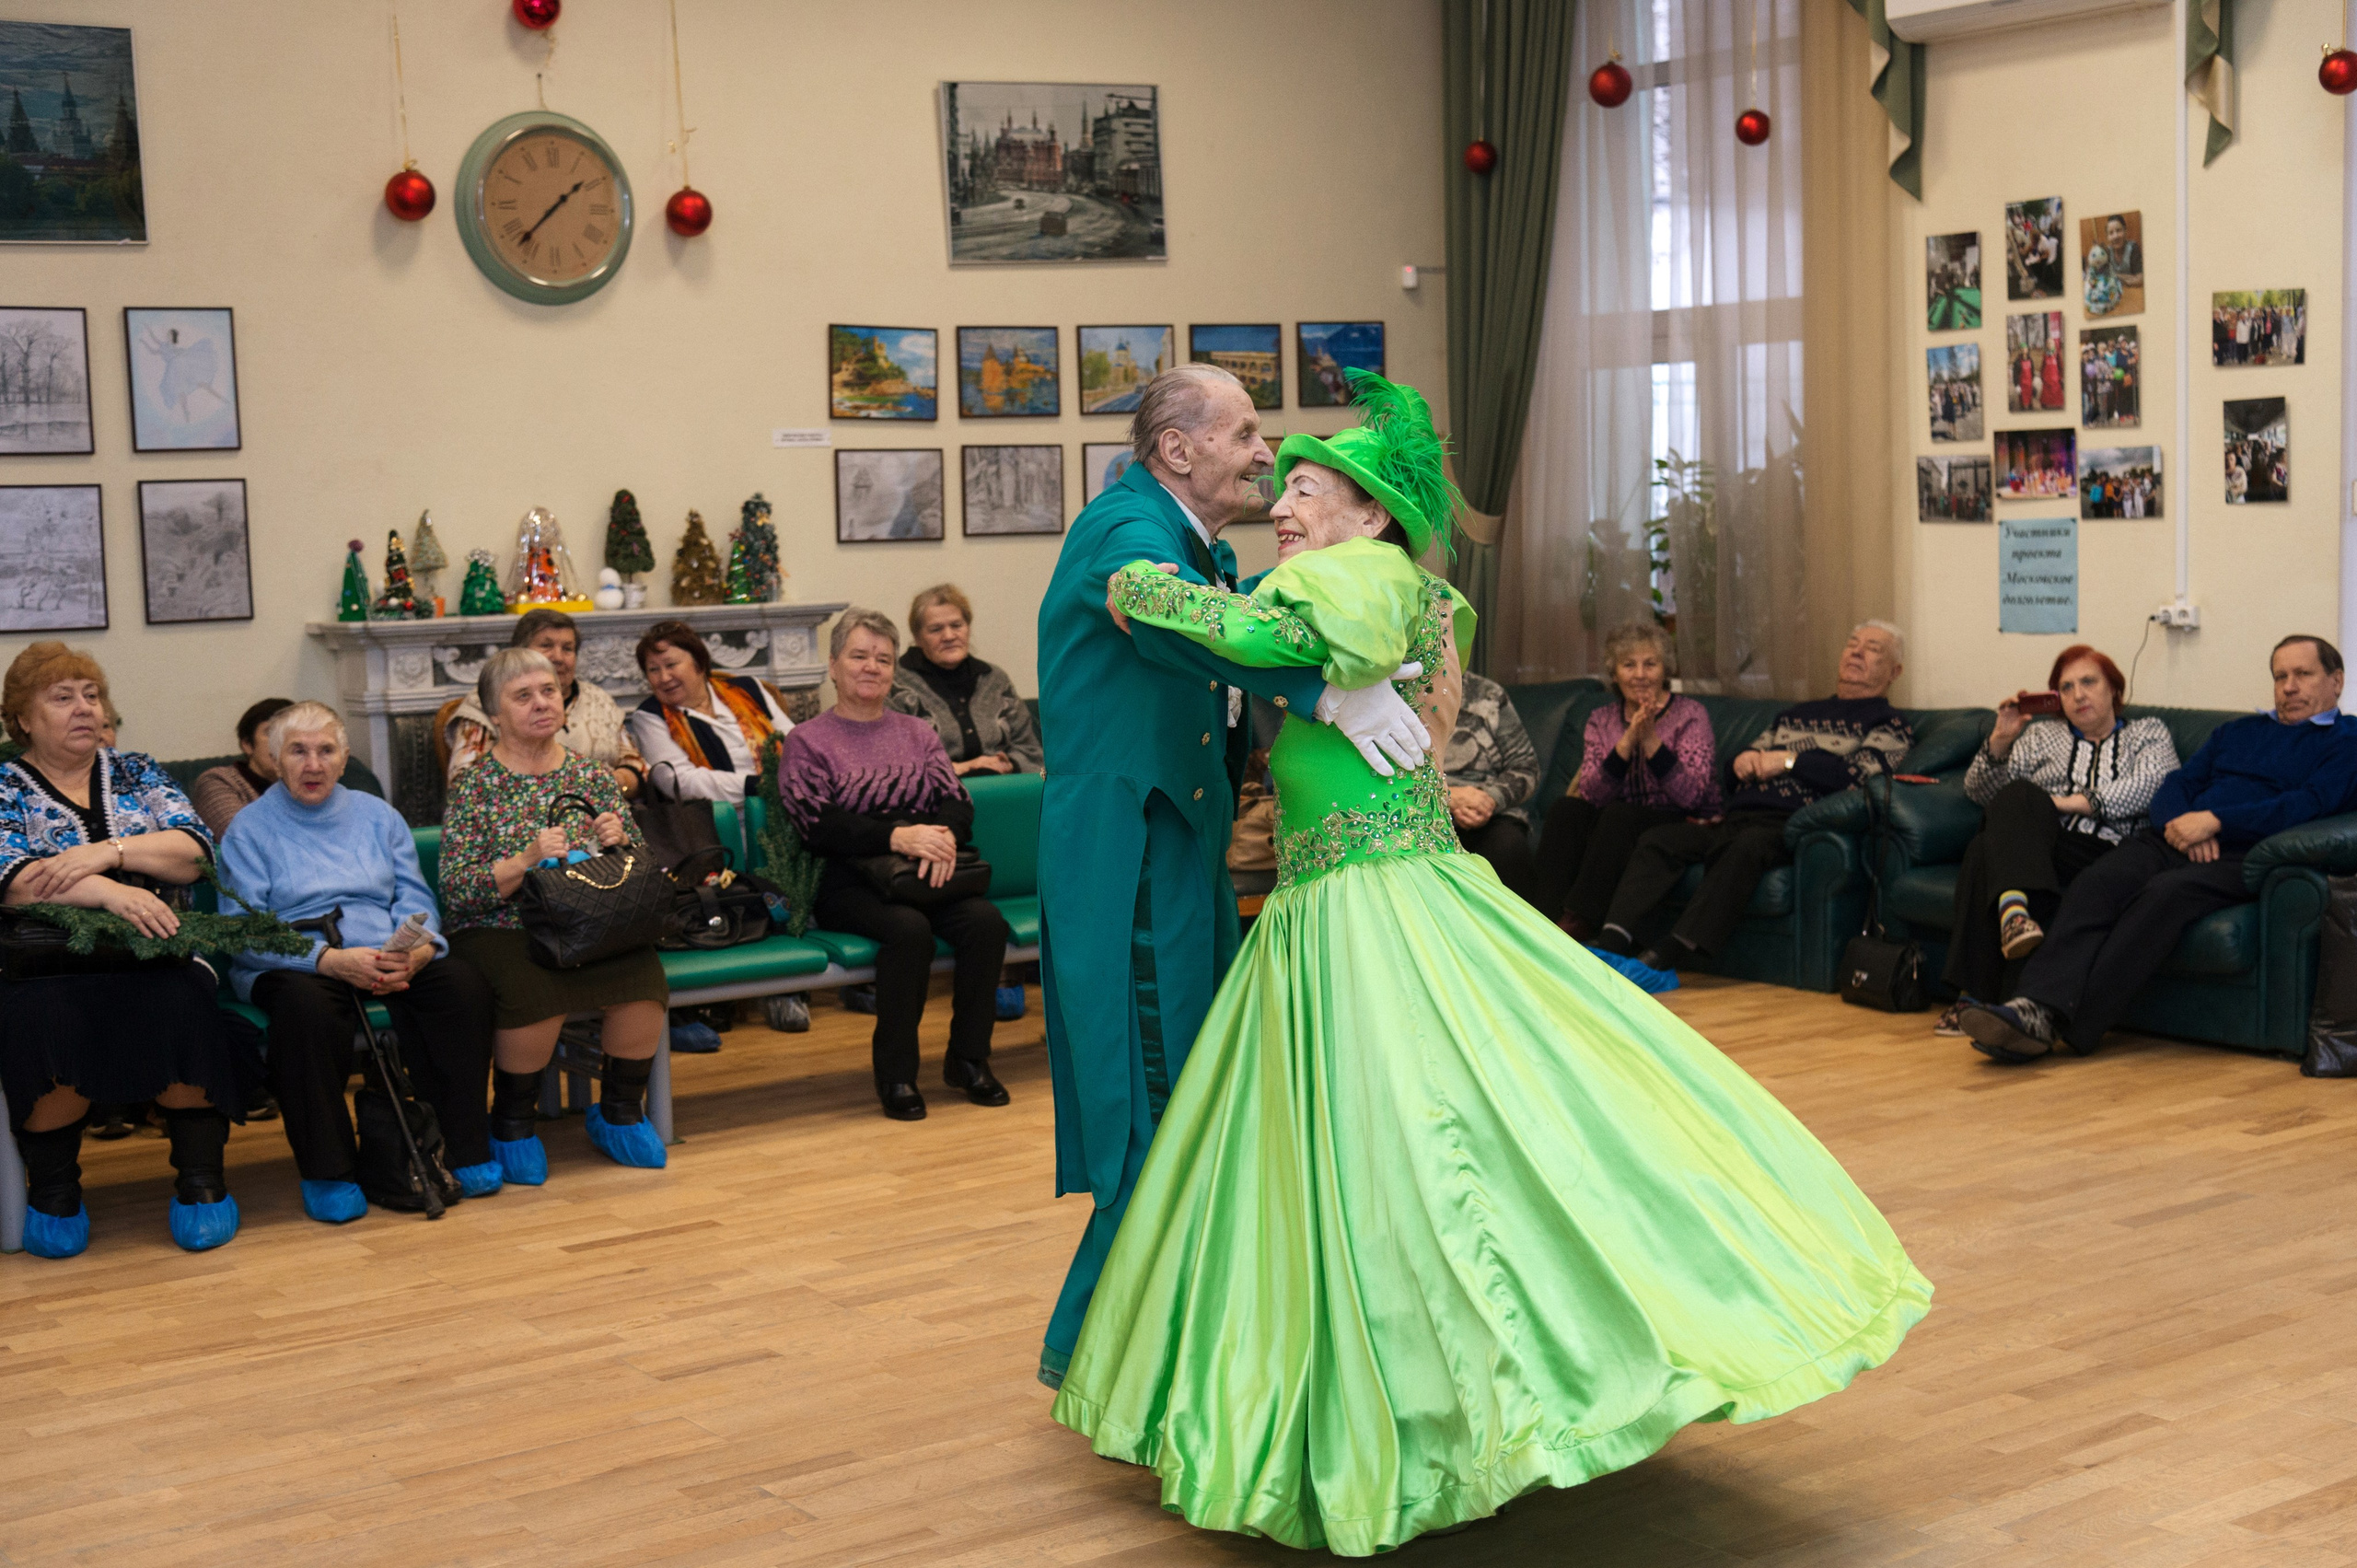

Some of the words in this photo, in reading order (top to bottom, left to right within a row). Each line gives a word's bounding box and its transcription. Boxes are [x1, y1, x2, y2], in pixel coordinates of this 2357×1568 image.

[2004, 526, 2071, 539] Участники
[2011, 550, 2062, 563] проекта
[2002, 571, 2073, 585] Московское
